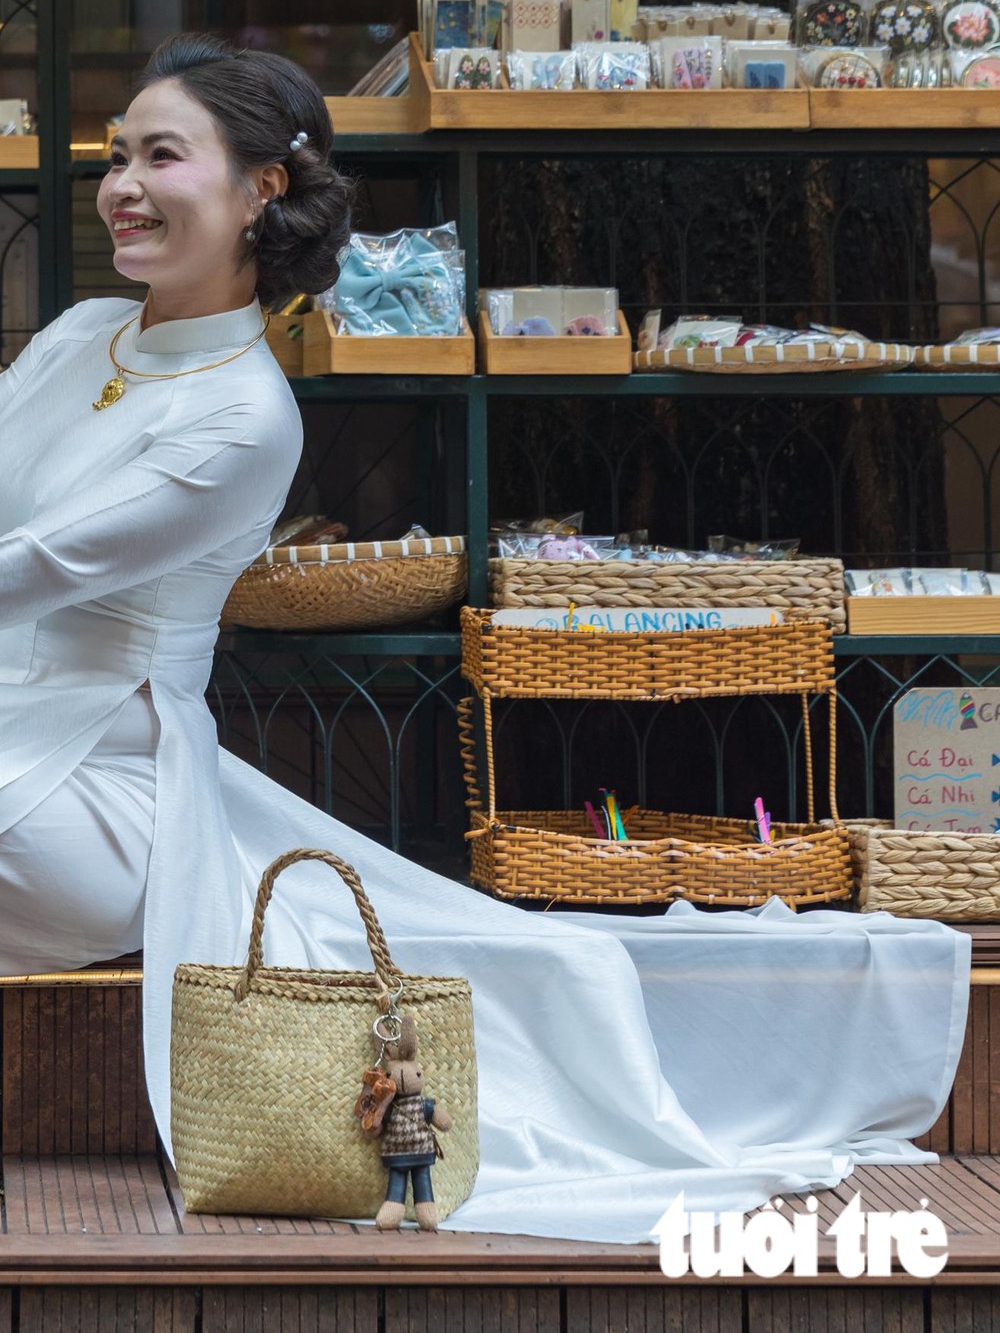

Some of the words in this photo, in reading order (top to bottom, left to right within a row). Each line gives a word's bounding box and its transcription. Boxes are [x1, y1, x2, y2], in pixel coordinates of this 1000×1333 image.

[907, 749, 931, 768] Cá
[938, 747, 974, 772] Đại
[907, 786, 932, 805] Cá
